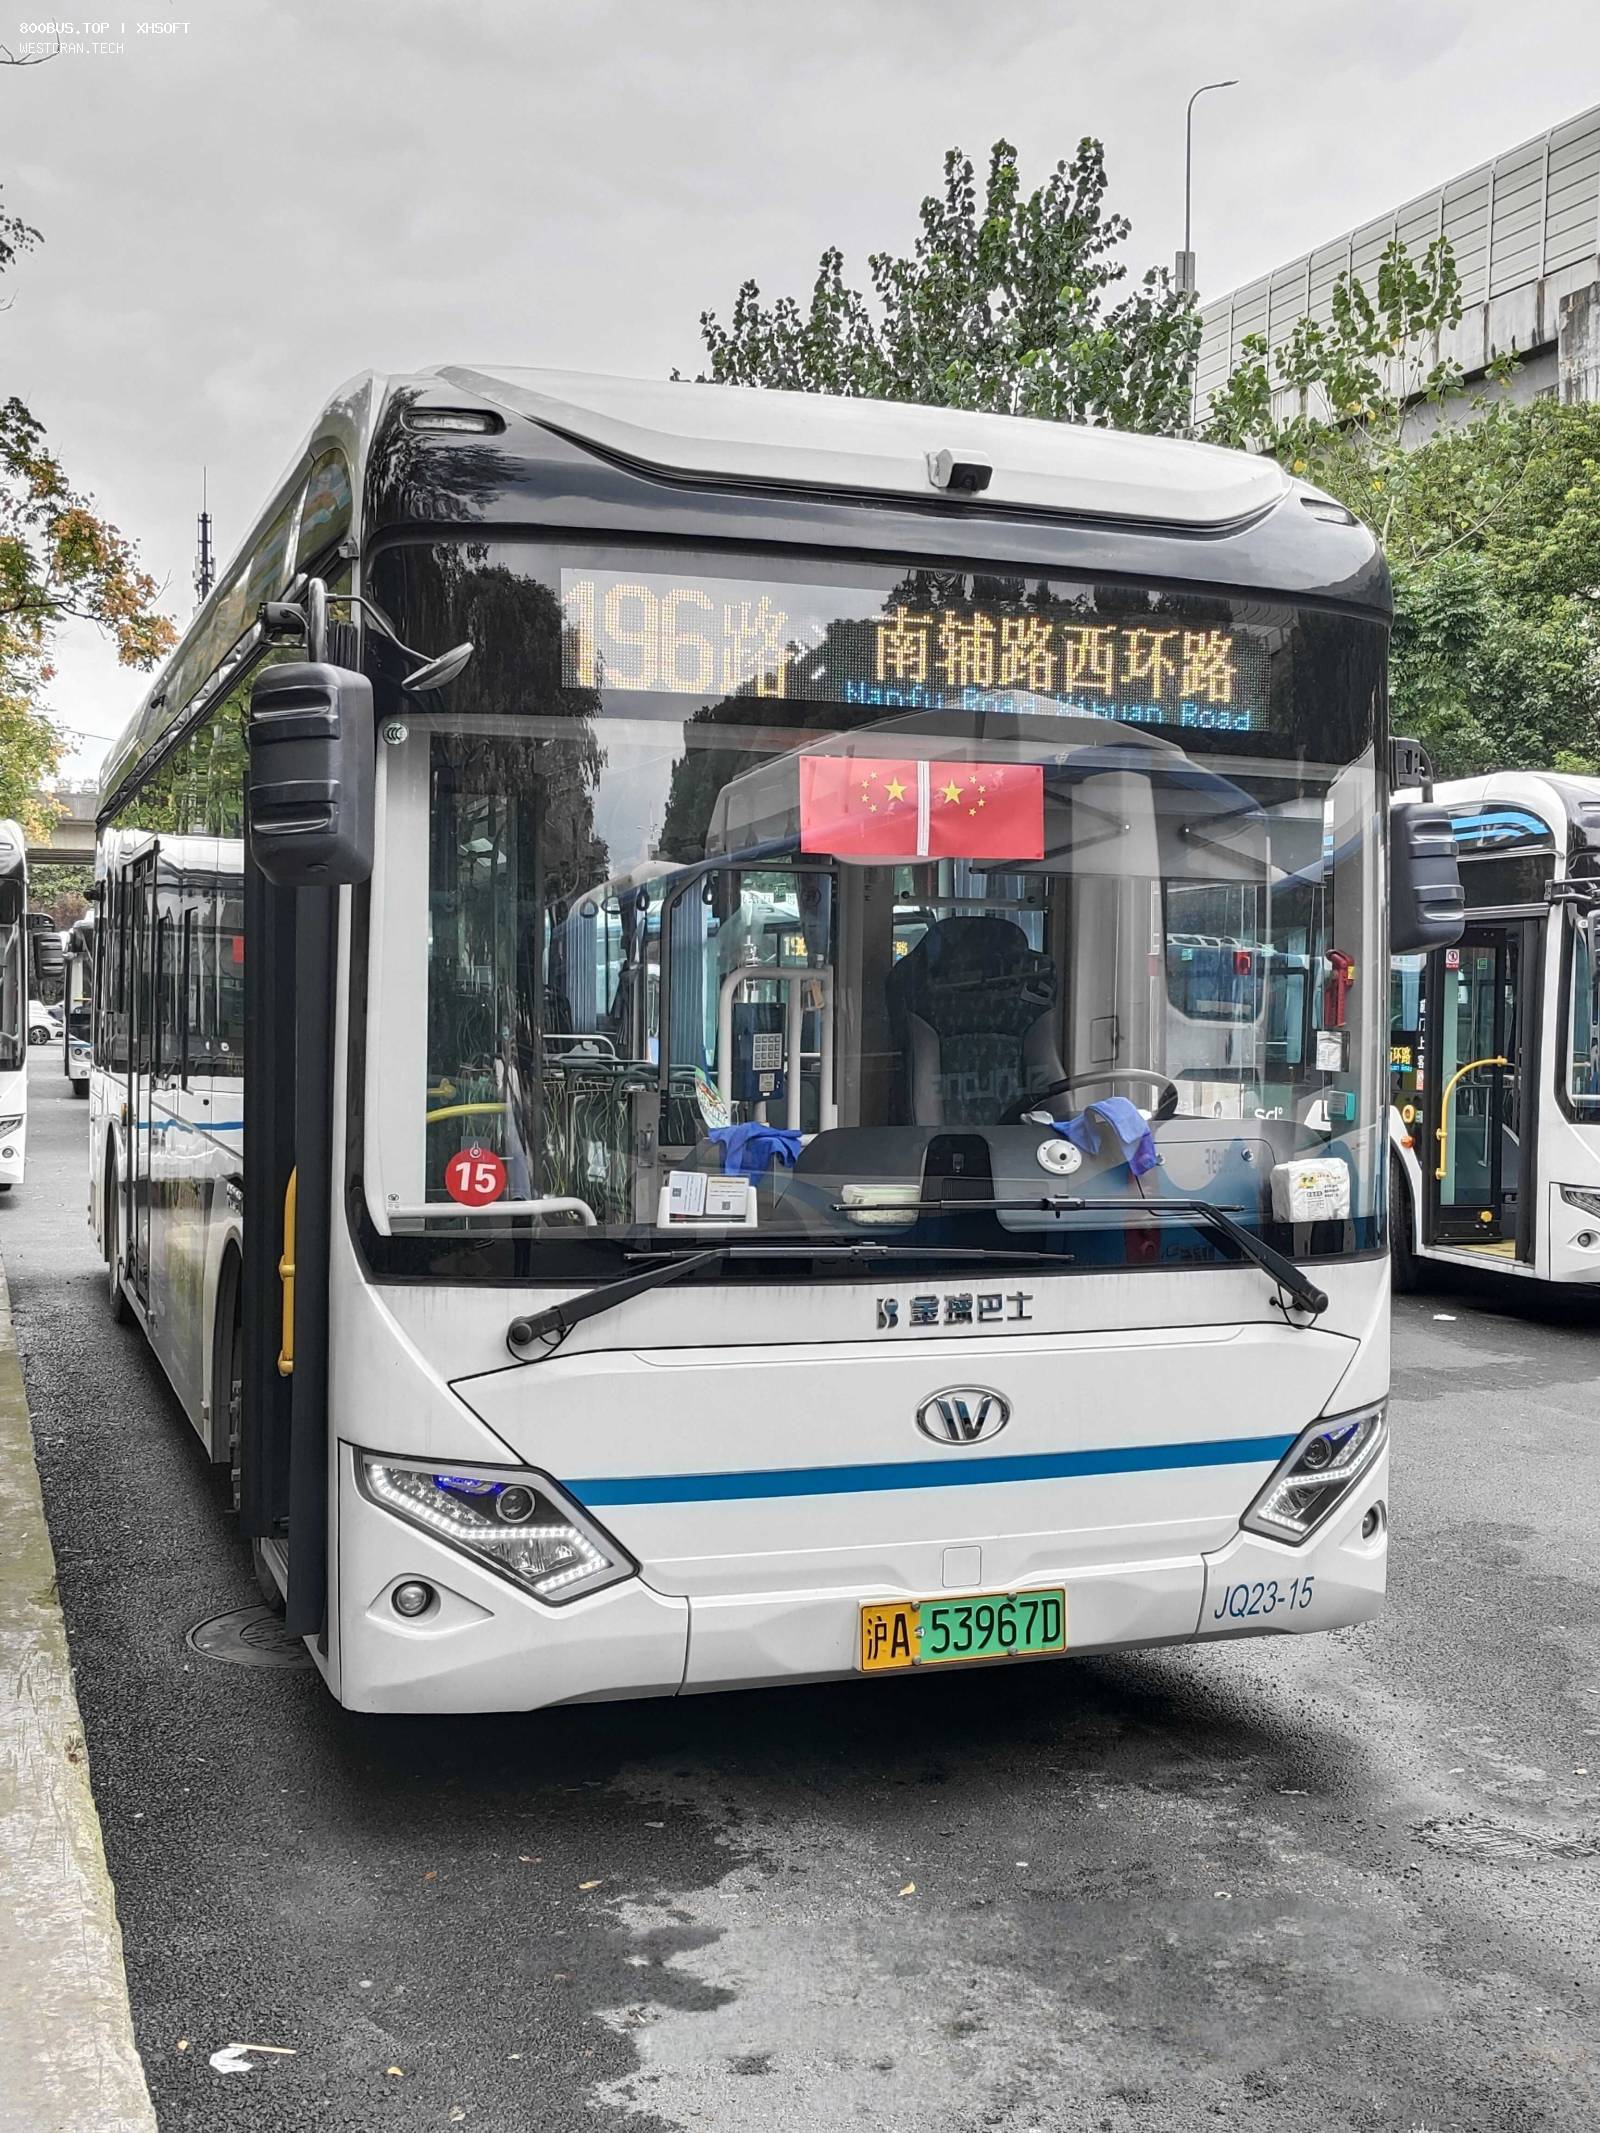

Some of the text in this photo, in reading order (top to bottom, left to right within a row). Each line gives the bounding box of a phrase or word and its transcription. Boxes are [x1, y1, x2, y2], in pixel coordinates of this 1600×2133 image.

[872, 605, 1239, 703] 南辅路西环路
[847, 681, 942, 709] Nanfu
[1181, 701, 1250, 731] Road
[455, 1161, 497, 1194] 15
[1212, 1575, 1316, 1619] JQ23-15
[865, 1598, 1062, 1661] 沪A 53967D
